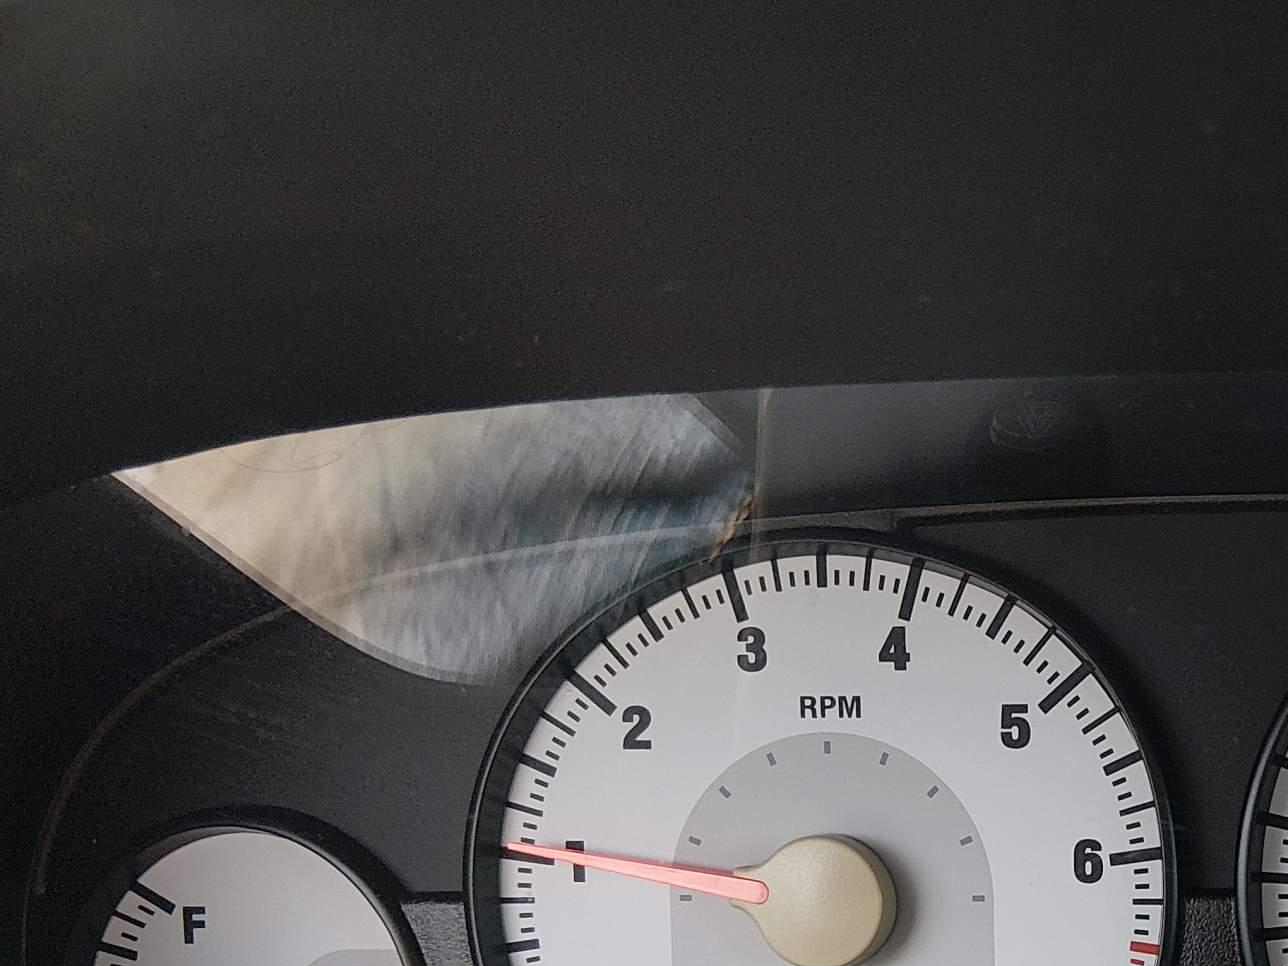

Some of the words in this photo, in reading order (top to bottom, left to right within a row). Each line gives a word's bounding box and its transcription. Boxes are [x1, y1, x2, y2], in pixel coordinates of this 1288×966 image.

[737, 627, 767, 672] 3
[879, 626, 910, 670] 4
[622, 706, 651, 749] 2
[800, 696, 861, 718] RPM
[1001, 704, 1030, 749] 5
[1074, 839, 1103, 883] 6
[183, 907, 205, 944] F
